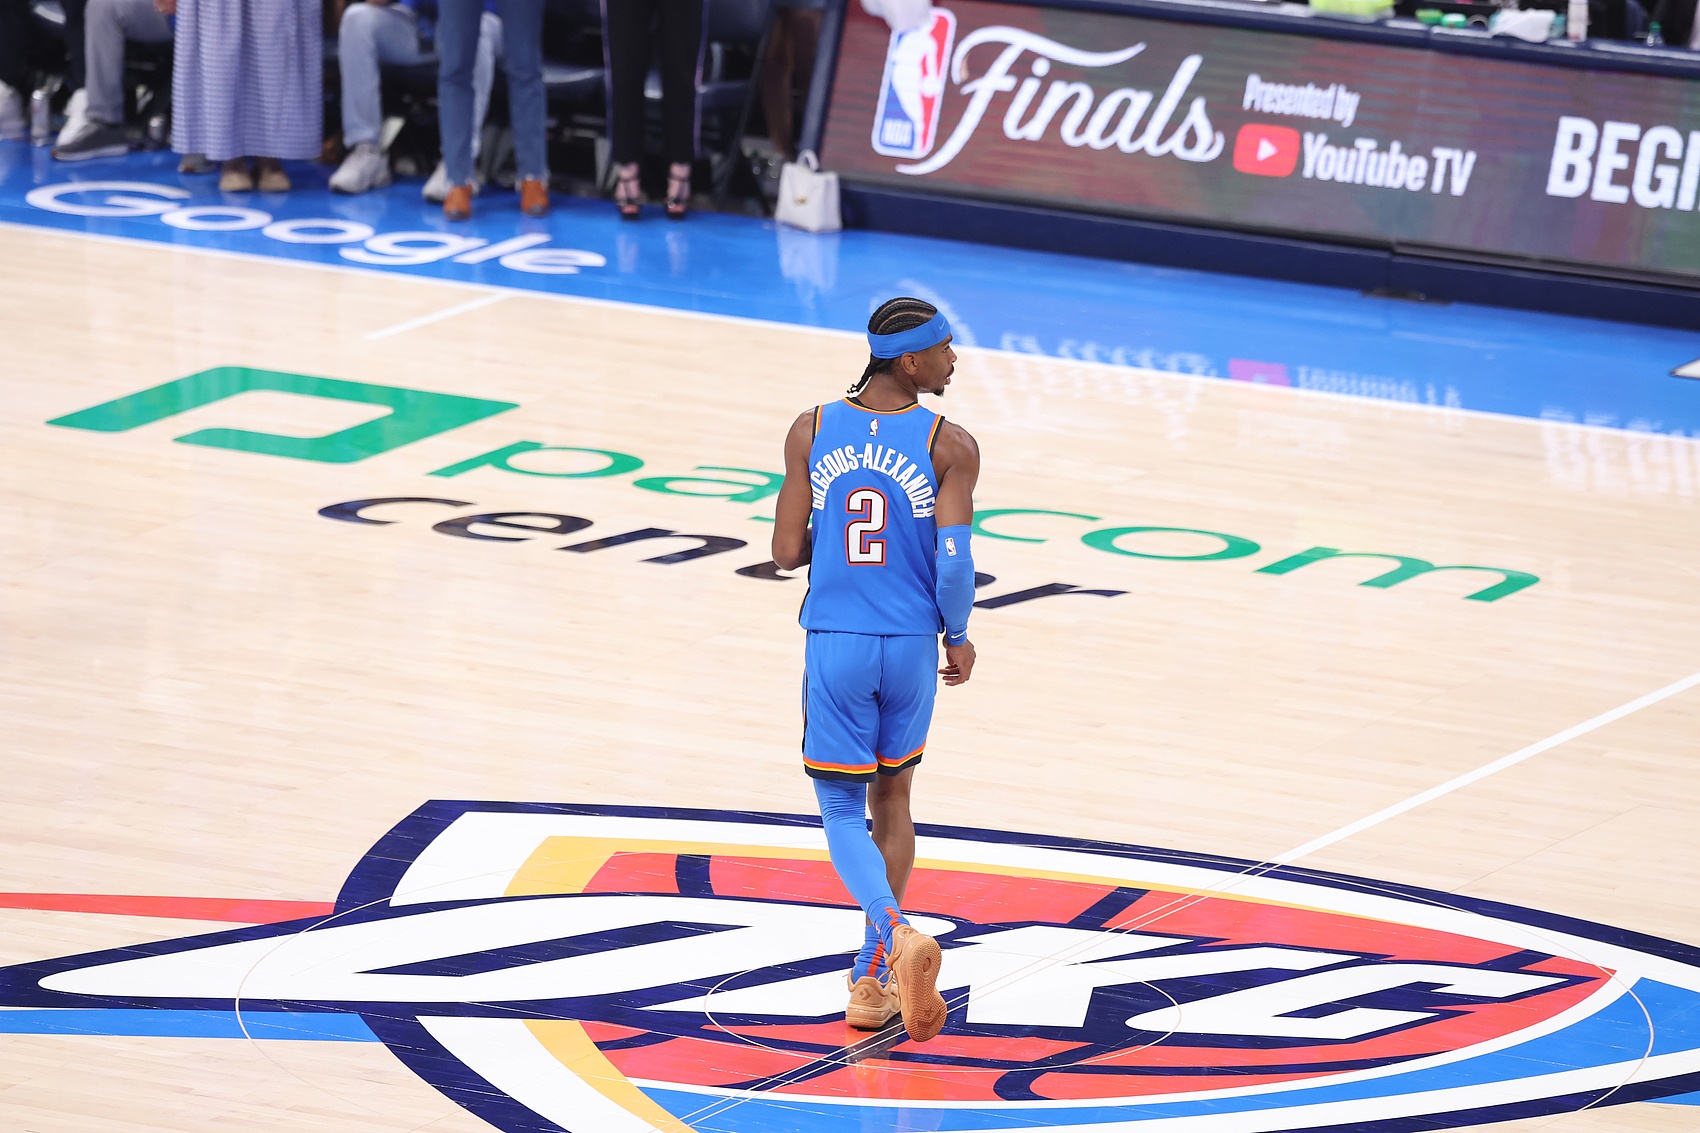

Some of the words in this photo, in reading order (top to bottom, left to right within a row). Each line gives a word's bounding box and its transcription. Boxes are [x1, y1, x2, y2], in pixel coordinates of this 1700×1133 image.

[895, 25, 1225, 176] Finals
[1242, 73, 1337, 121] Presented
[1332, 83, 1361, 128] by
[1302, 131, 1429, 192] YouTube
[1430, 145, 1477, 197] TV
[1545, 115, 1700, 211] BEGI
[25, 180, 607, 275] Google
[317, 496, 1130, 610] cenr
[425, 440, 1541, 603] pacom
[845, 485, 889, 566] 2
